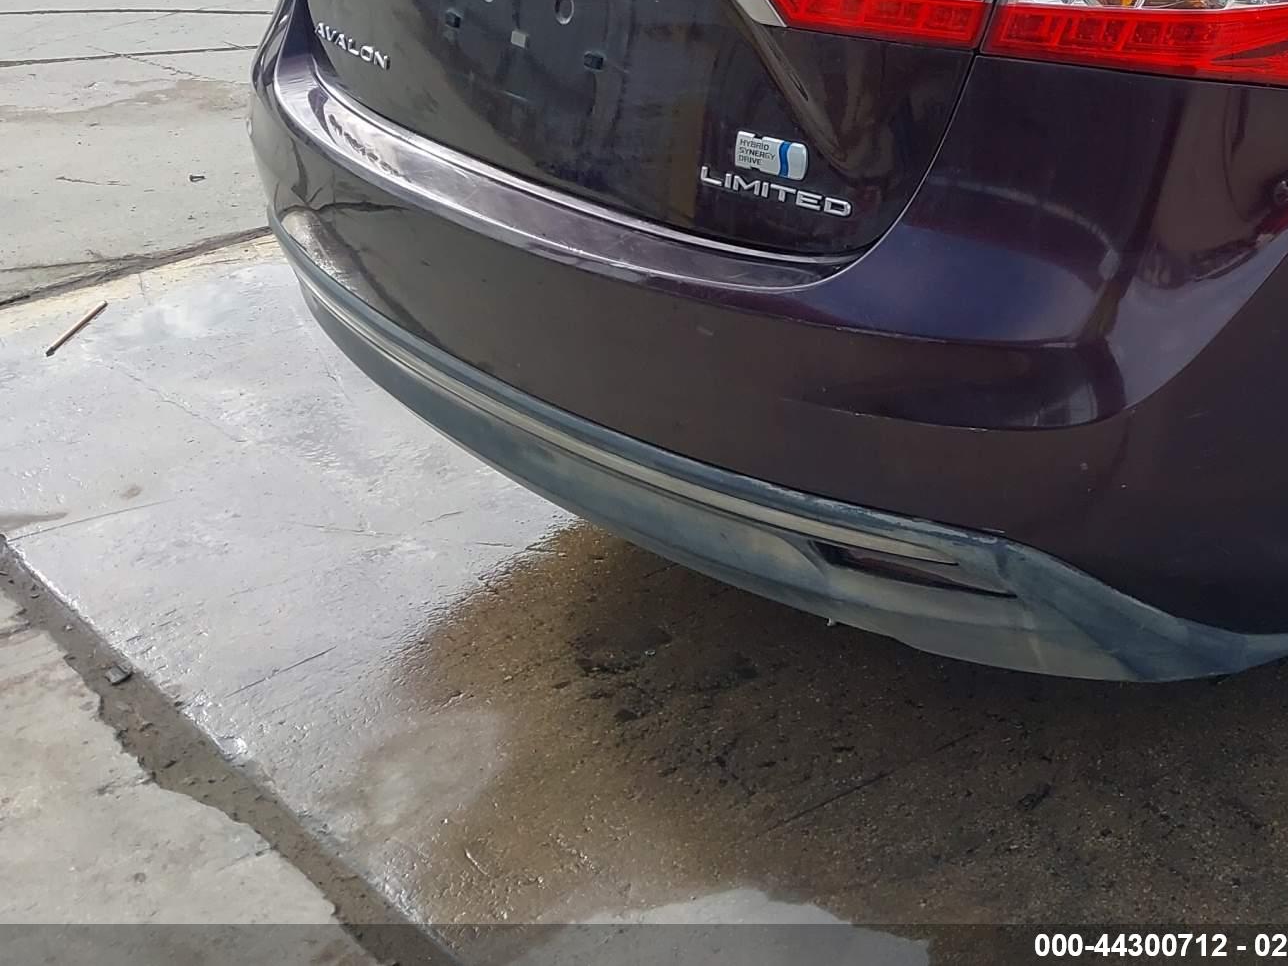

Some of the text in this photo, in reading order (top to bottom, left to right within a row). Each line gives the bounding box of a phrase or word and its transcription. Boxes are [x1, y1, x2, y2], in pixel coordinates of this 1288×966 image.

[314, 22, 390, 70] AVALON
[740, 138, 770, 151] HYBRID
[738, 154, 762, 165] DRIVE
[739, 146, 776, 161] SYNERGY
[700, 165, 852, 218] LIMITED
